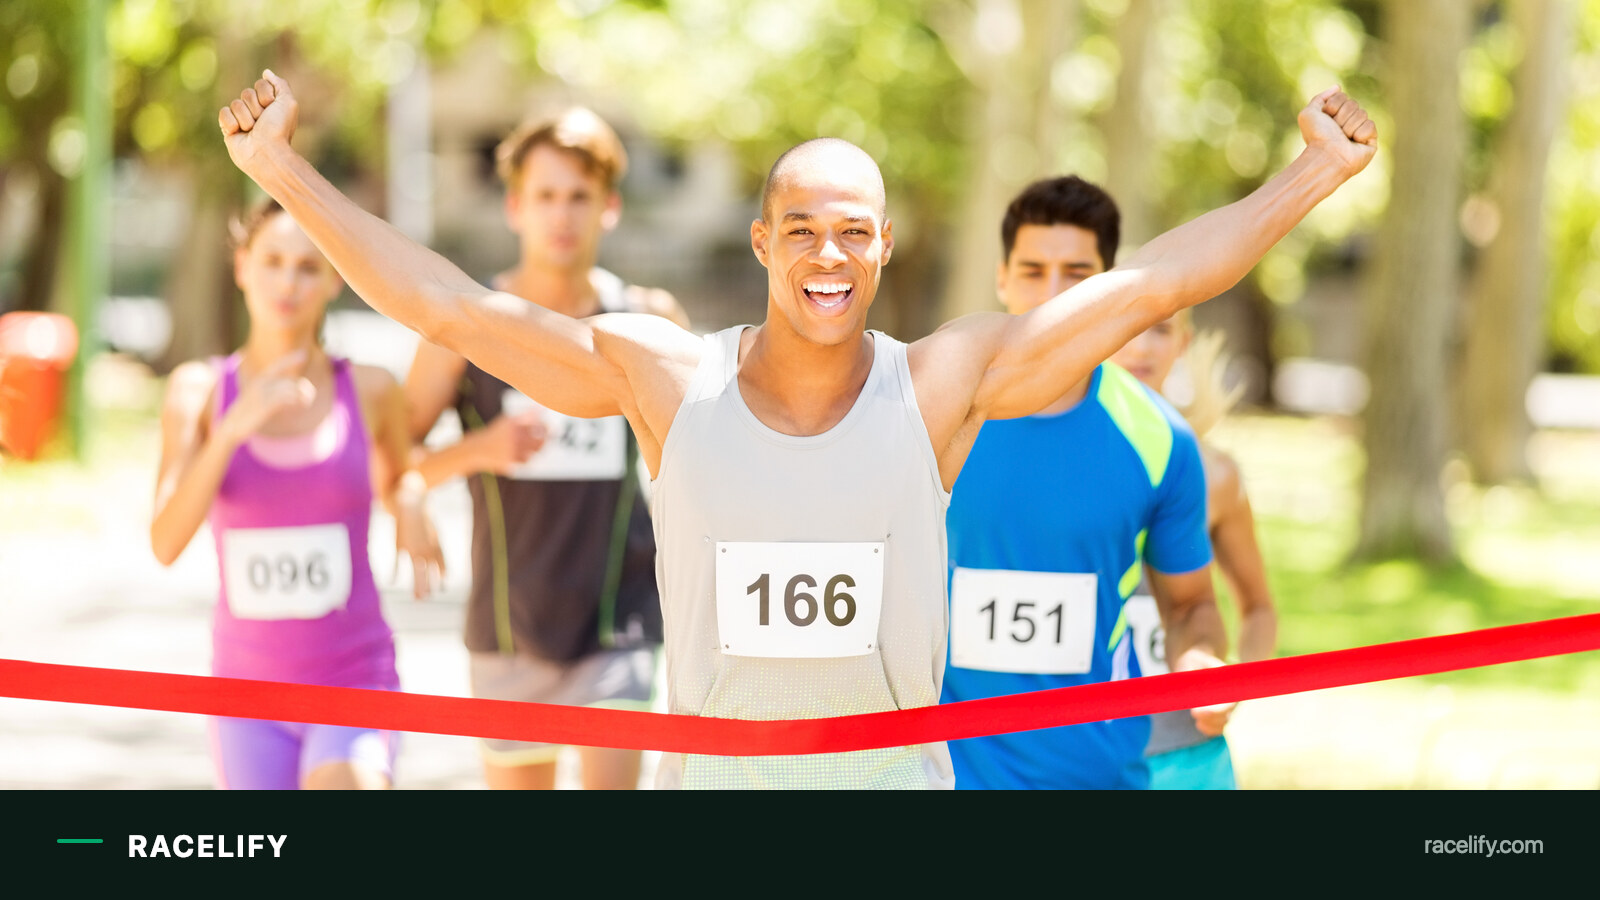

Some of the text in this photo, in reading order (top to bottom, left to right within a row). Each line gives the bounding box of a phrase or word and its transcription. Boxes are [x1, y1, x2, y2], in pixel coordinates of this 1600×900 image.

[248, 551, 331, 593] 096
[746, 573, 857, 627] 166
[979, 599, 1064, 644] 151
